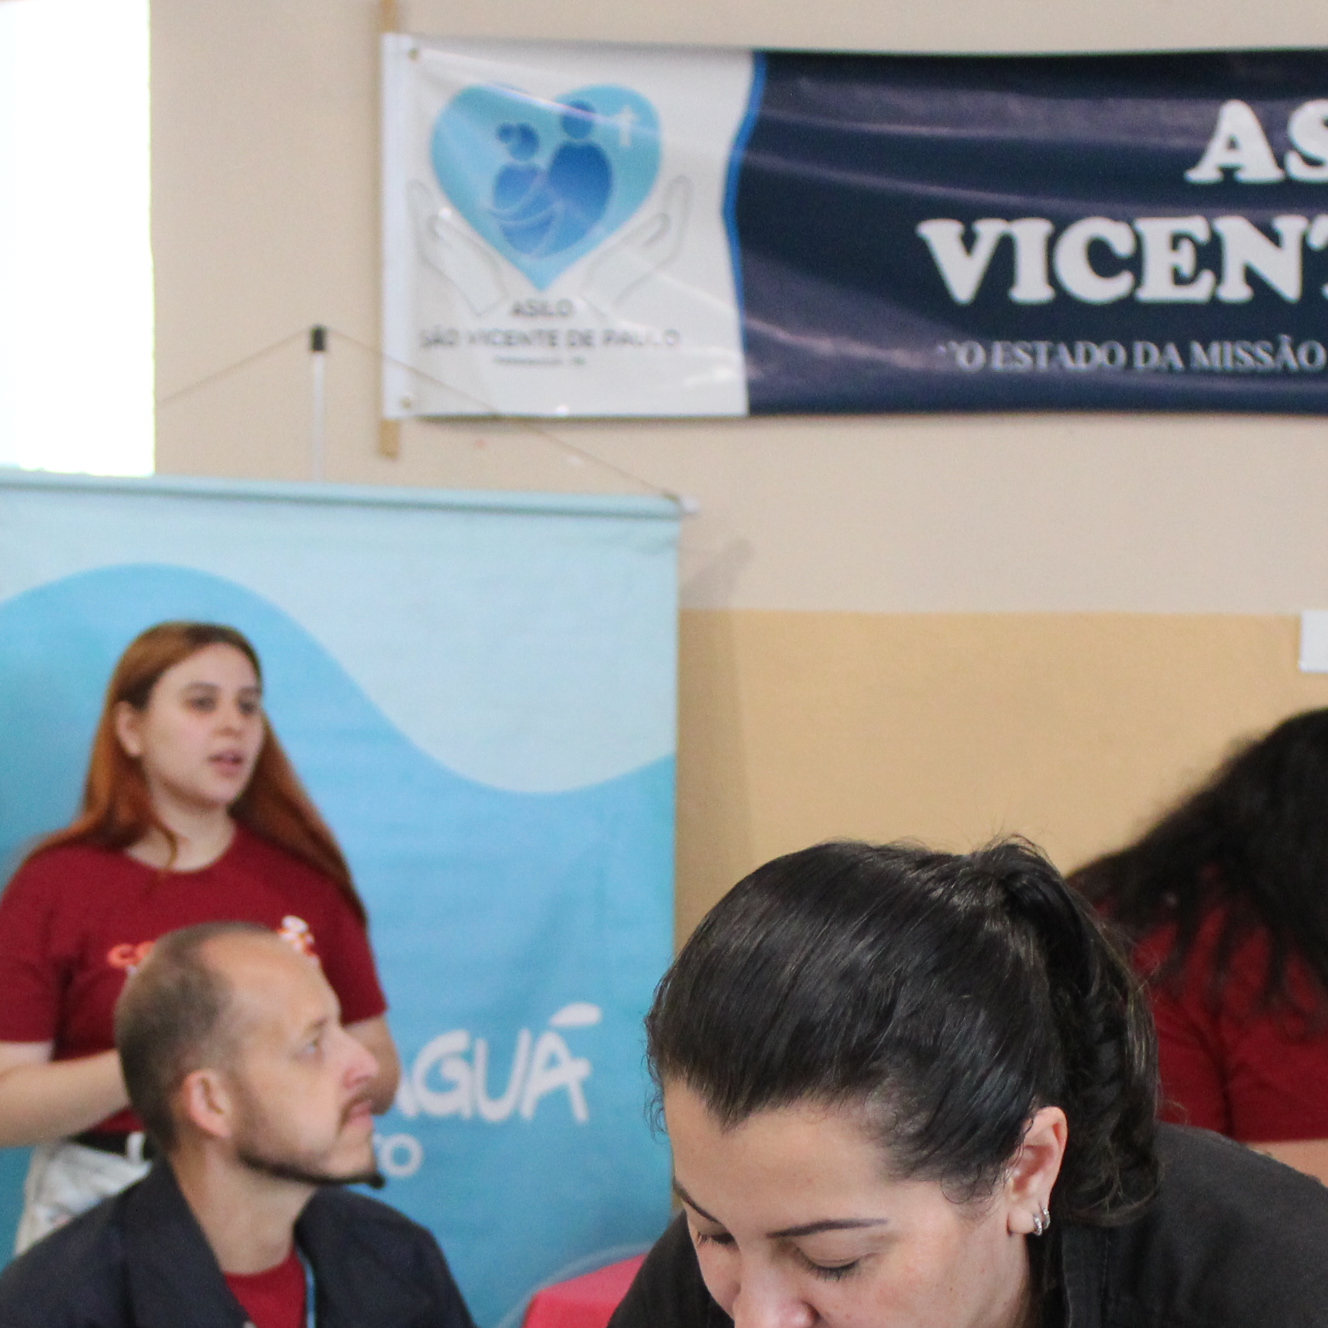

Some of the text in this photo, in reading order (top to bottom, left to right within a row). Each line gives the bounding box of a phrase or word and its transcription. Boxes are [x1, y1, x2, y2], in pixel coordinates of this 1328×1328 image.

[511, 298, 574, 317] ASILO
[468, 328, 558, 347] VICENTE
[566, 328, 595, 347] DE
[991, 340, 1127, 371] ESTADO
[1132, 340, 1185, 371] DA
[1188, 334, 1327, 371] MISSÃO
